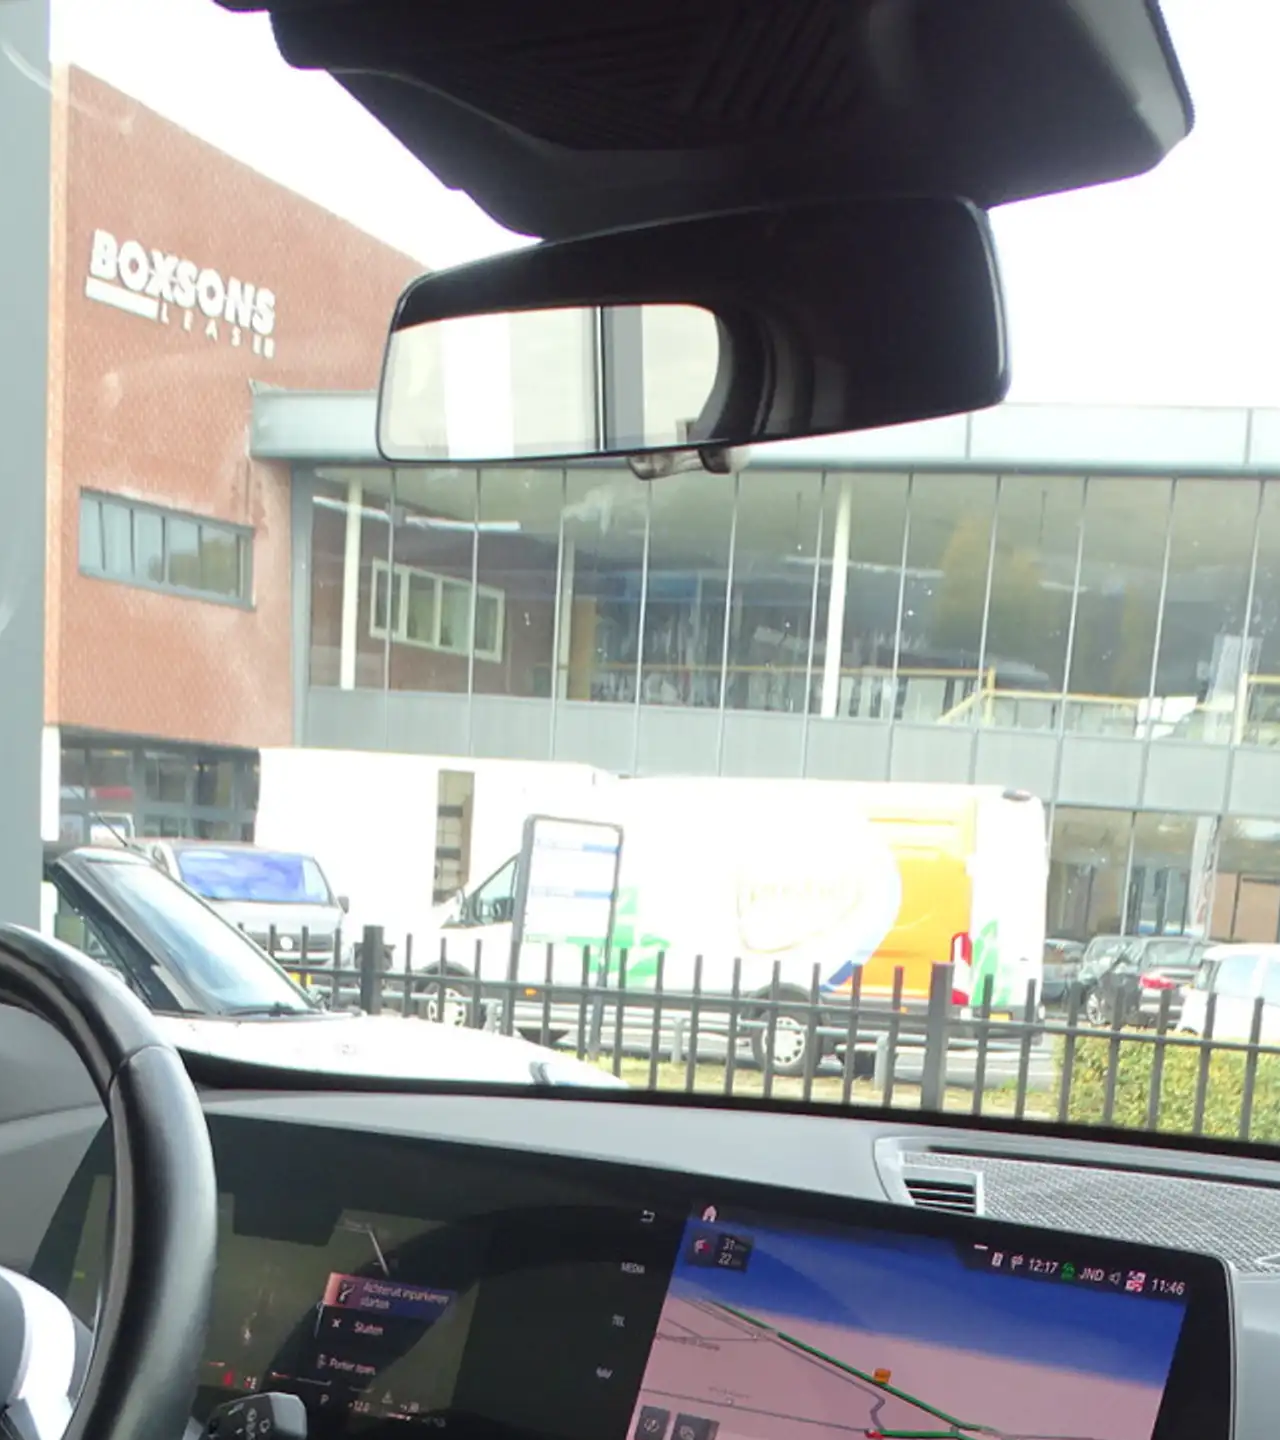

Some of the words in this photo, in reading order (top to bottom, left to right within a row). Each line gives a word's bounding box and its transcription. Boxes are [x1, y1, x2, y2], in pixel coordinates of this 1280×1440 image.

[89, 228, 275, 336] BOXSONS
[1028, 1257, 1059, 1274] 12:17
[1079, 1267, 1104, 1283] JND
[1151, 1278, 1185, 1296] 11:46
